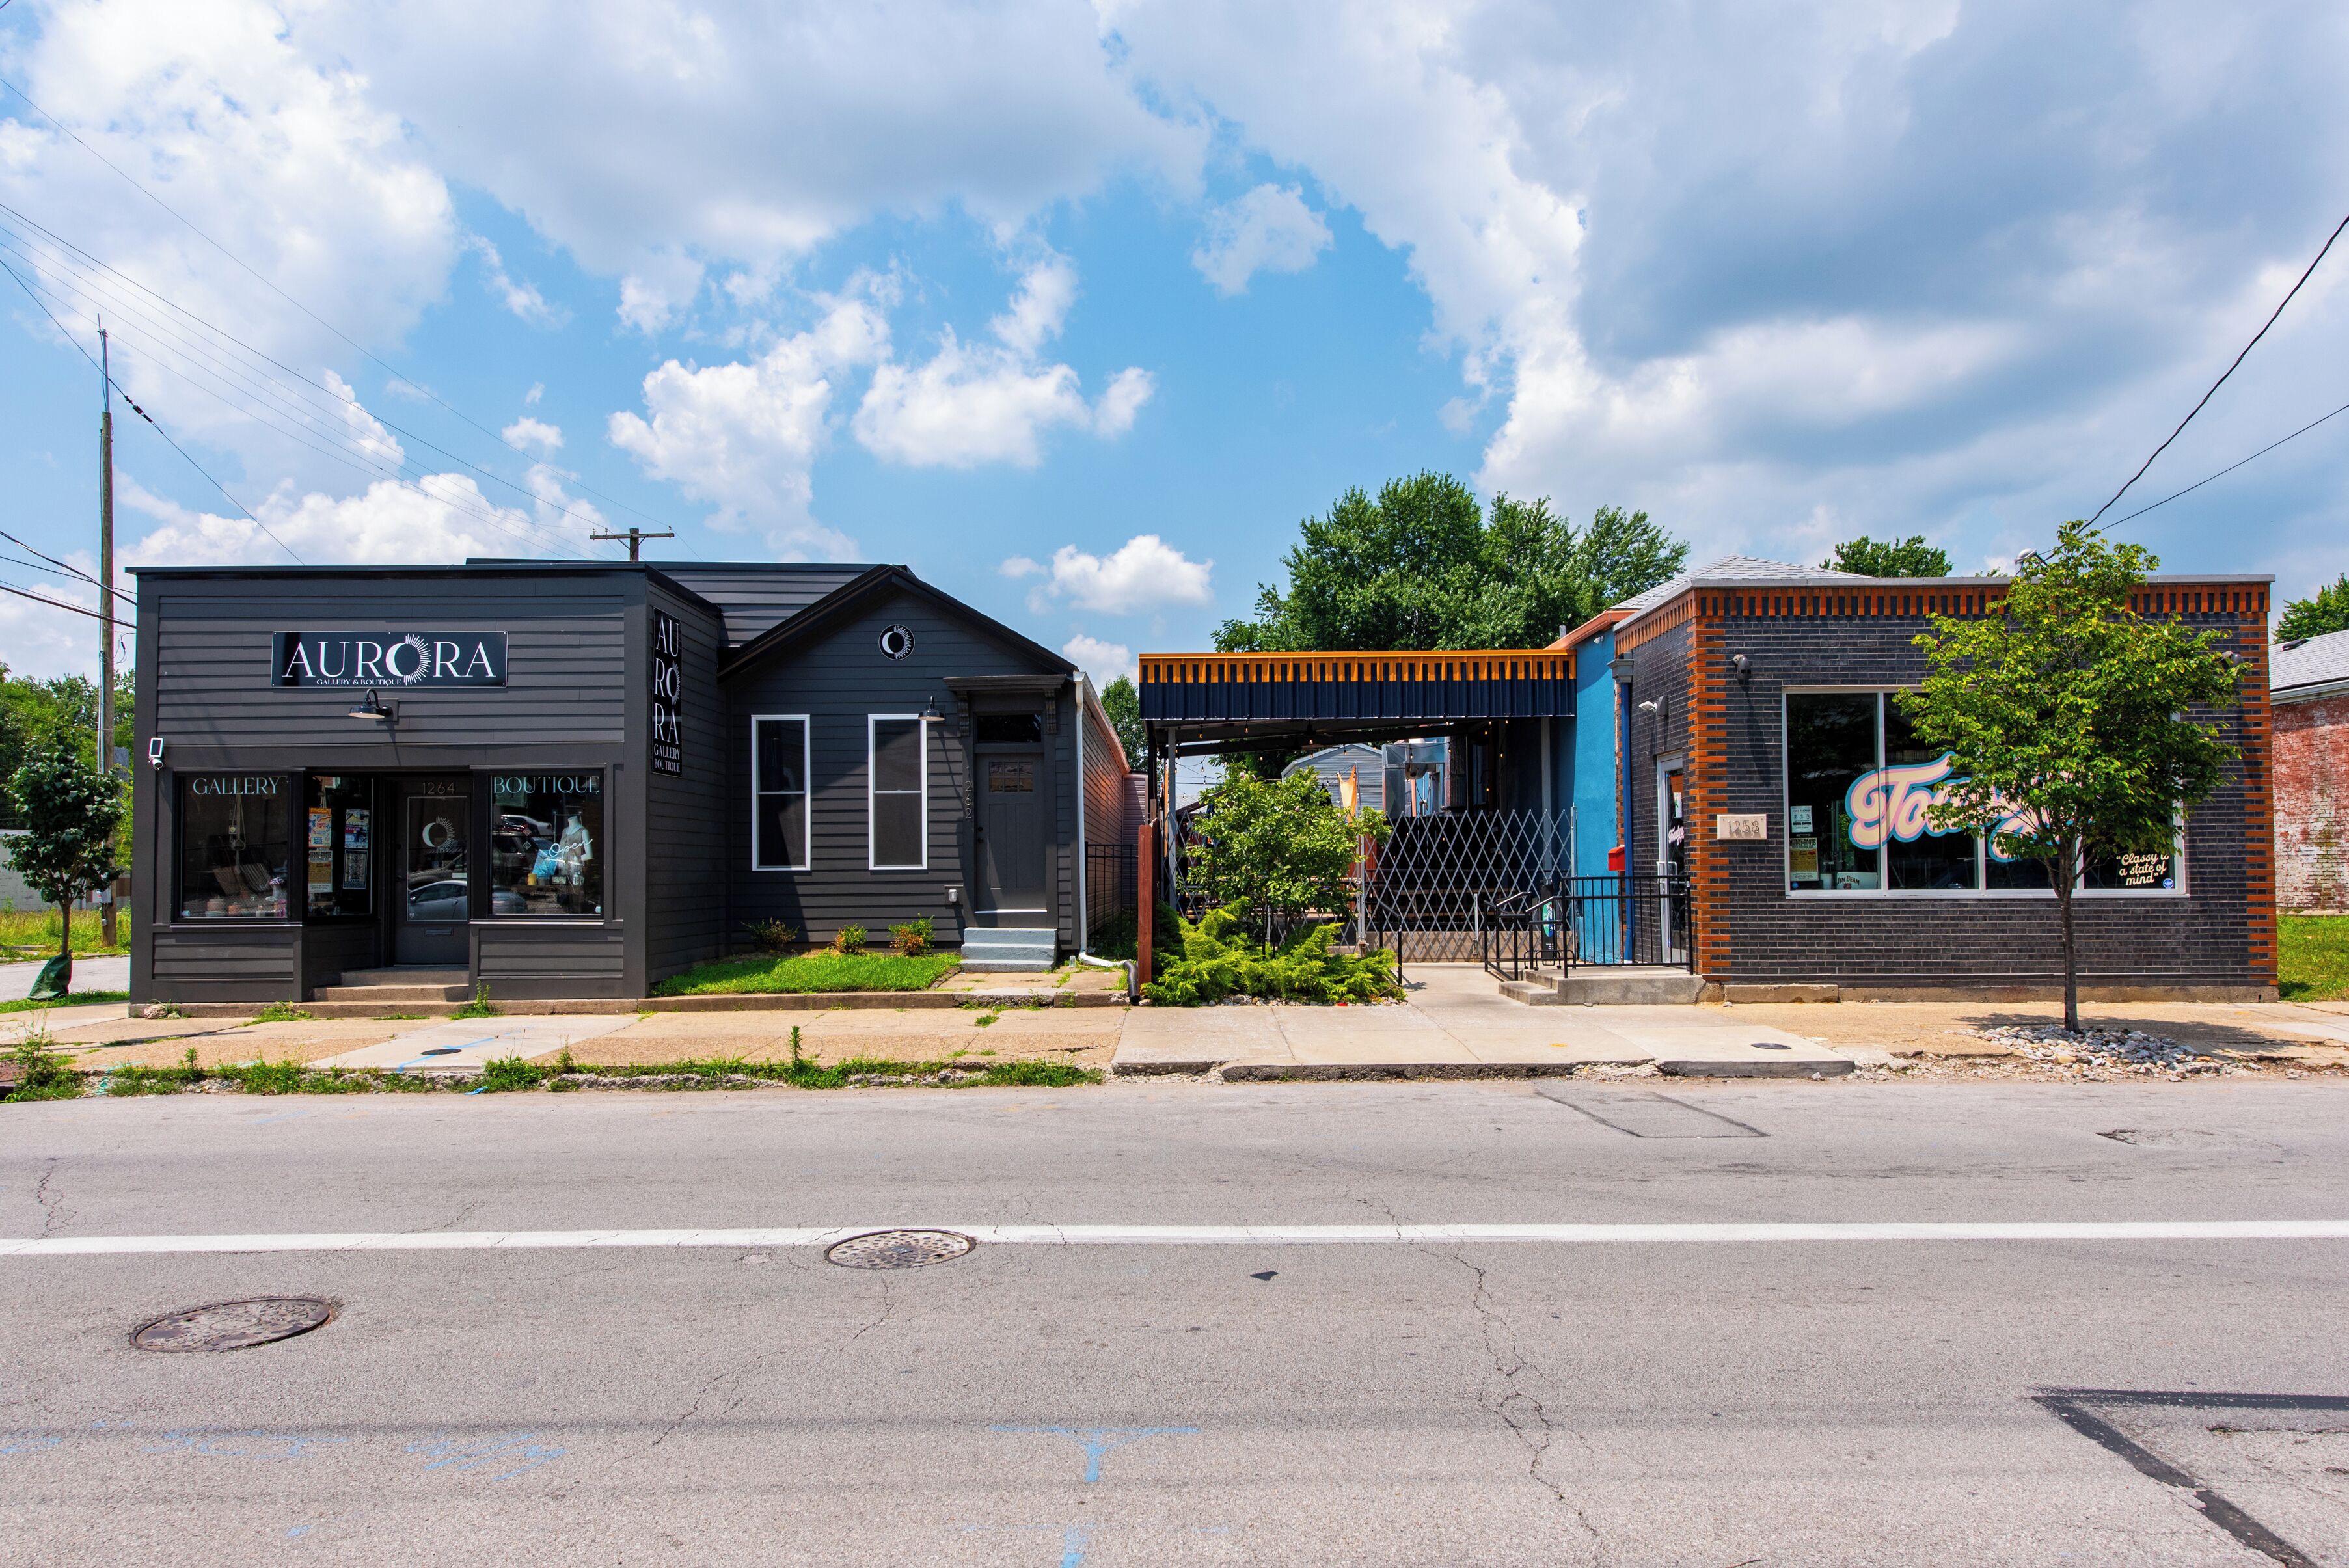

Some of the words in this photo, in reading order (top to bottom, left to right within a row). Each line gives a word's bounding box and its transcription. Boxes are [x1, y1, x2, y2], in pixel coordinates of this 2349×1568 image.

[282, 636, 496, 682] AURORA
[653, 744, 681, 761] GALLERY
[654, 757, 681, 774] BOUTIQUE
[193, 777, 280, 795] GALLERY
[422, 782, 455, 794] 1264
[493, 776, 601, 794] BOUTIQUE
[1728, 820, 1759, 833] 1258
[549, 839, 593, 860] Open
[2129, 862, 2154, 875] state
[2156, 860, 2167, 875] of
[1837, 876, 1846, 885] JIM
[1847, 875, 1860, 886] BEAM
